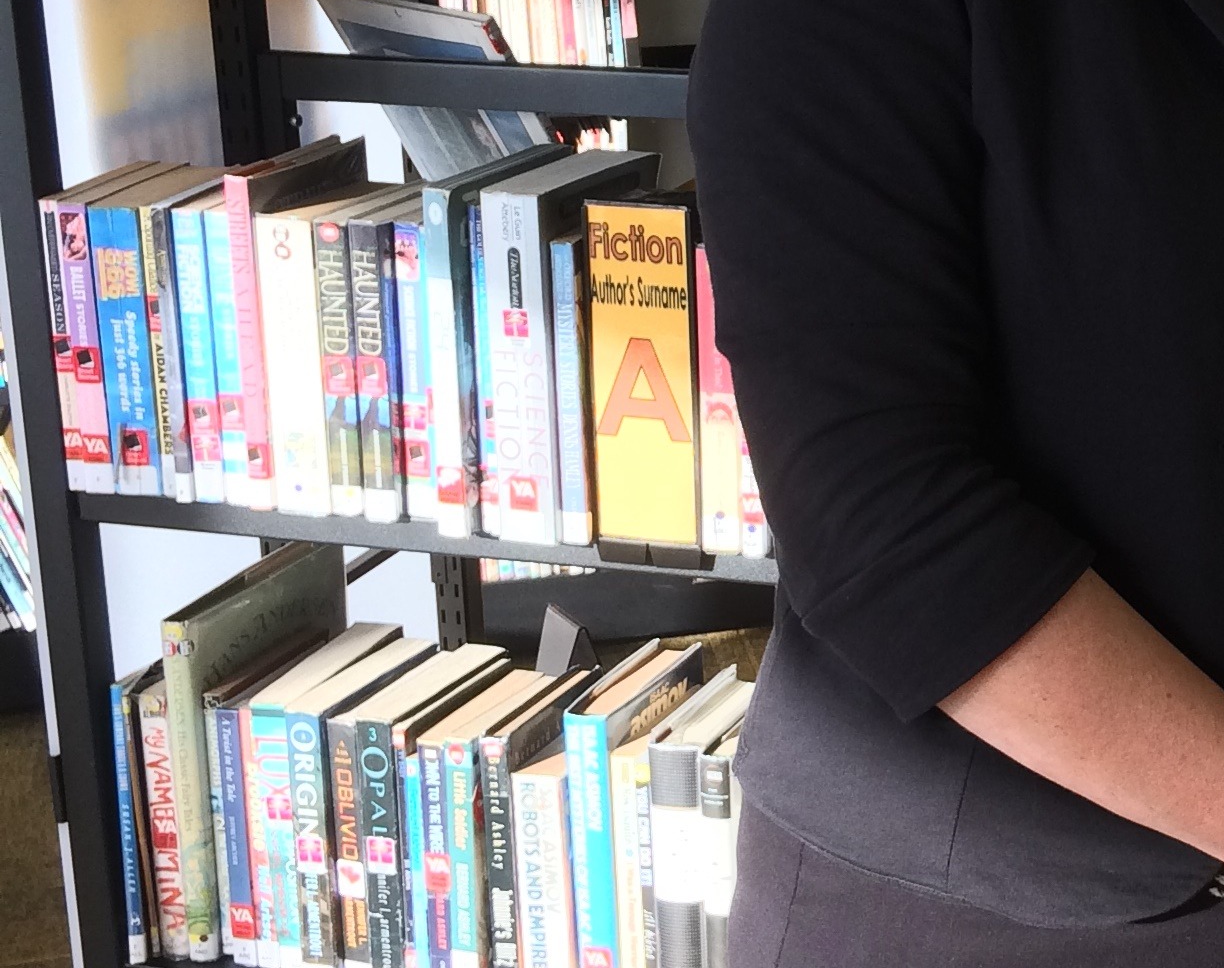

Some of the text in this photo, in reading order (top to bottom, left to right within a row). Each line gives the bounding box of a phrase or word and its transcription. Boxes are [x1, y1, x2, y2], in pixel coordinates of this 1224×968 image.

[69, 265, 88, 302] BALLET
[588, 221, 684, 265] Fiction
[52, 273, 65, 333] SEASON
[316, 250, 349, 355] HAUNTED
[351, 250, 383, 356] HAUNTED
[590, 276, 687, 310] Author's Surname
[109, 318, 130, 412] just 366 words
[124, 310, 143, 404] Speedy stories
[154, 342, 173, 455] AIDAN CHAMBERS
[557, 301, 578, 410] MYSTERY STORIES
[597, 337, 692, 442] A
[83, 436, 107, 455] YA
[493, 348, 523, 487] FICTION
[522, 351, 550, 491] SCIENCE
[222, 727, 236, 803] Twist the Tale
[289, 721, 320, 838] ORIGIN
[360, 746, 389, 838] OPAL
[450, 770, 469, 851] Little Soldier
[485, 756, 506, 871] Bernard Ashley
[143, 727, 186, 931] My NAME MINA
[518, 781, 548, 968] ROBOTS AND EMPIRE
[231, 906, 252, 924] YA
